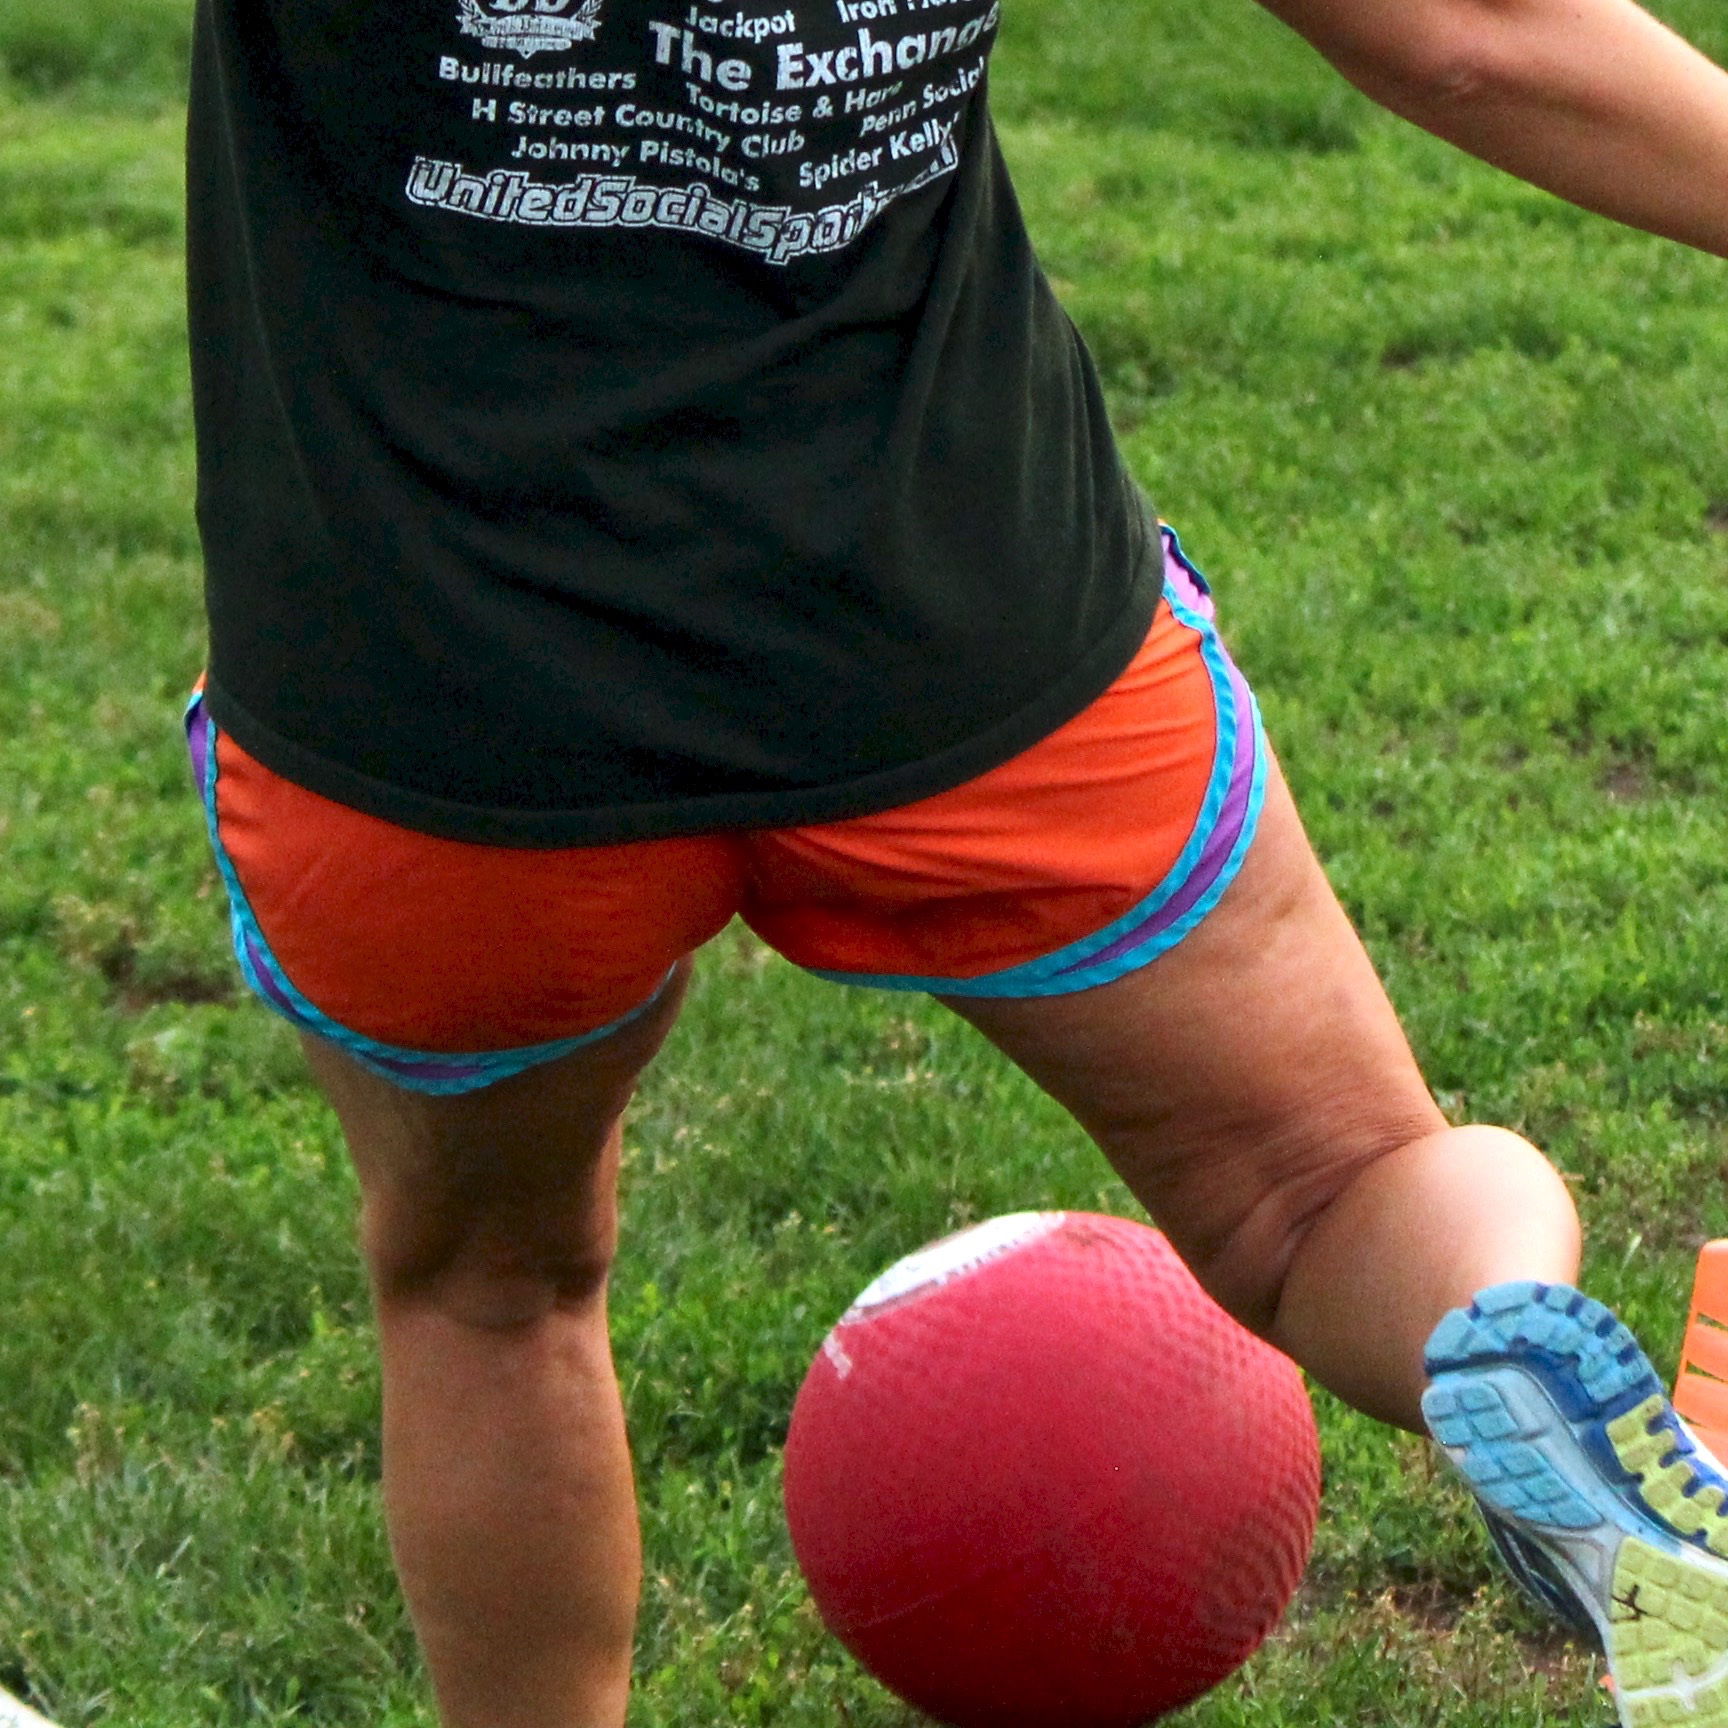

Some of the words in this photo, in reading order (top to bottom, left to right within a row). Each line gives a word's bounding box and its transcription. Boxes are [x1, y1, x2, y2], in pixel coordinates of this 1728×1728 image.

[685, 7, 796, 44] Jackpot
[439, 55, 637, 90] Bullfeathers
[649, 21, 752, 91] The
[685, 81, 803, 125] Tortoise
[812, 95, 834, 119] &
[858, 100, 917, 138] Penn
[472, 97, 497, 121] H
[508, 101, 606, 126] Street
[614, 104, 732, 153] Country
[741, 129, 805, 159] Club
[511, 136, 630, 168] Johnny
[639, 139, 761, 193] Pistola's
[799, 146, 884, 191] Spider
